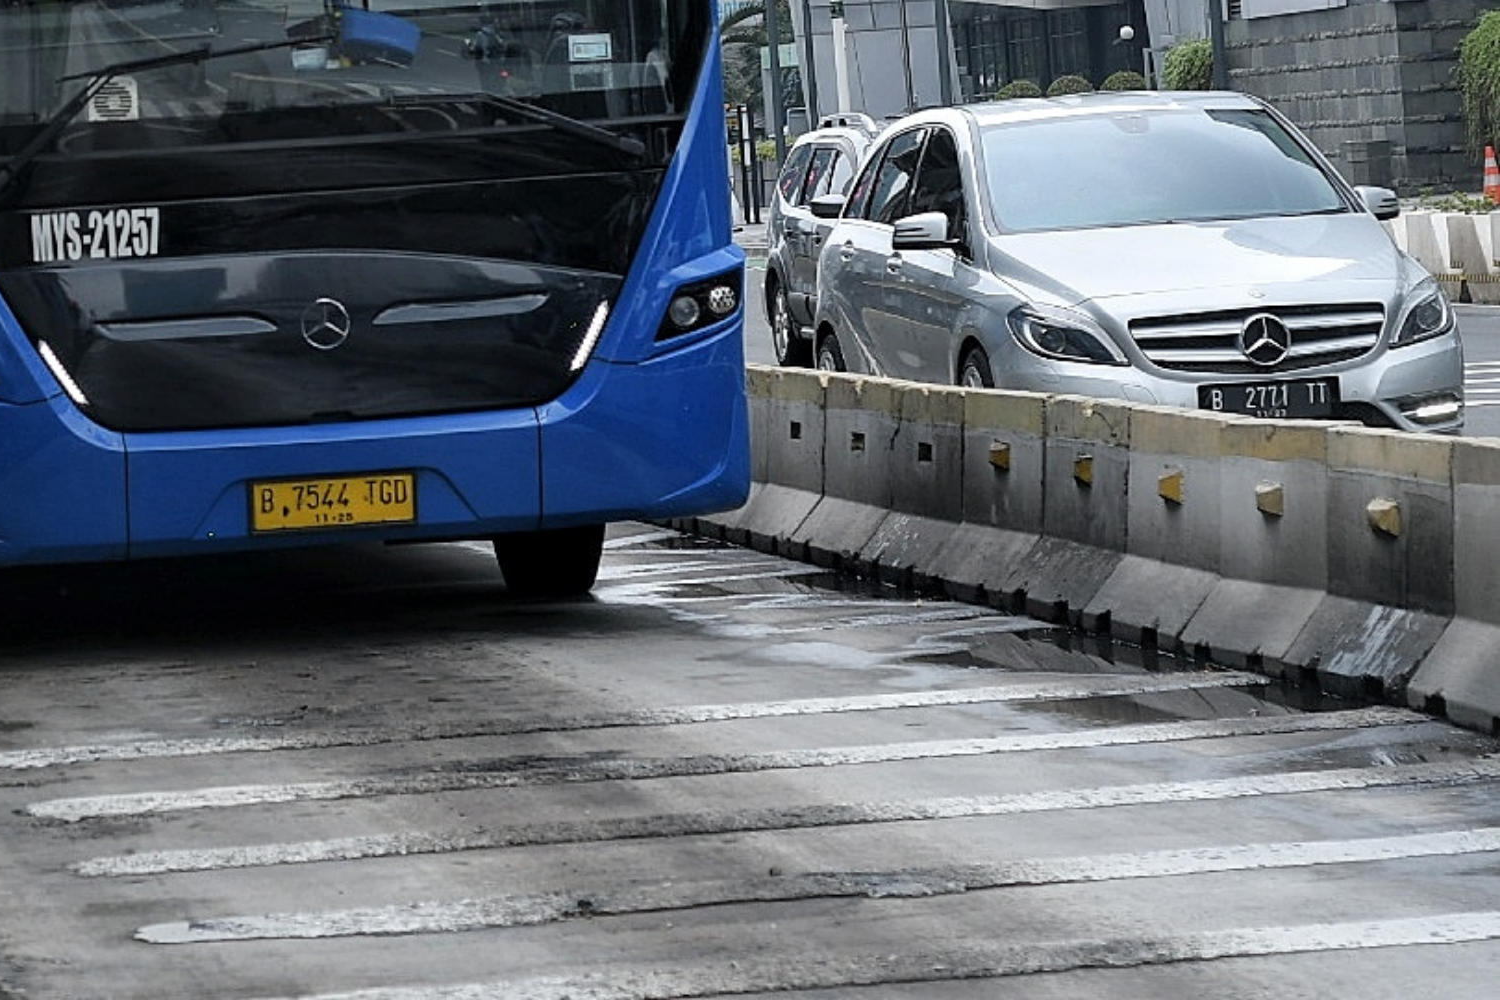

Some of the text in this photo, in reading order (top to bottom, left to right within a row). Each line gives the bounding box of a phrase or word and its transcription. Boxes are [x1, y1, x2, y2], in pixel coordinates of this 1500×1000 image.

[31, 207, 160, 262] MYS-21257
[1212, 382, 1327, 410] B 2771 TT
[261, 479, 408, 513] B 7544 TGD
